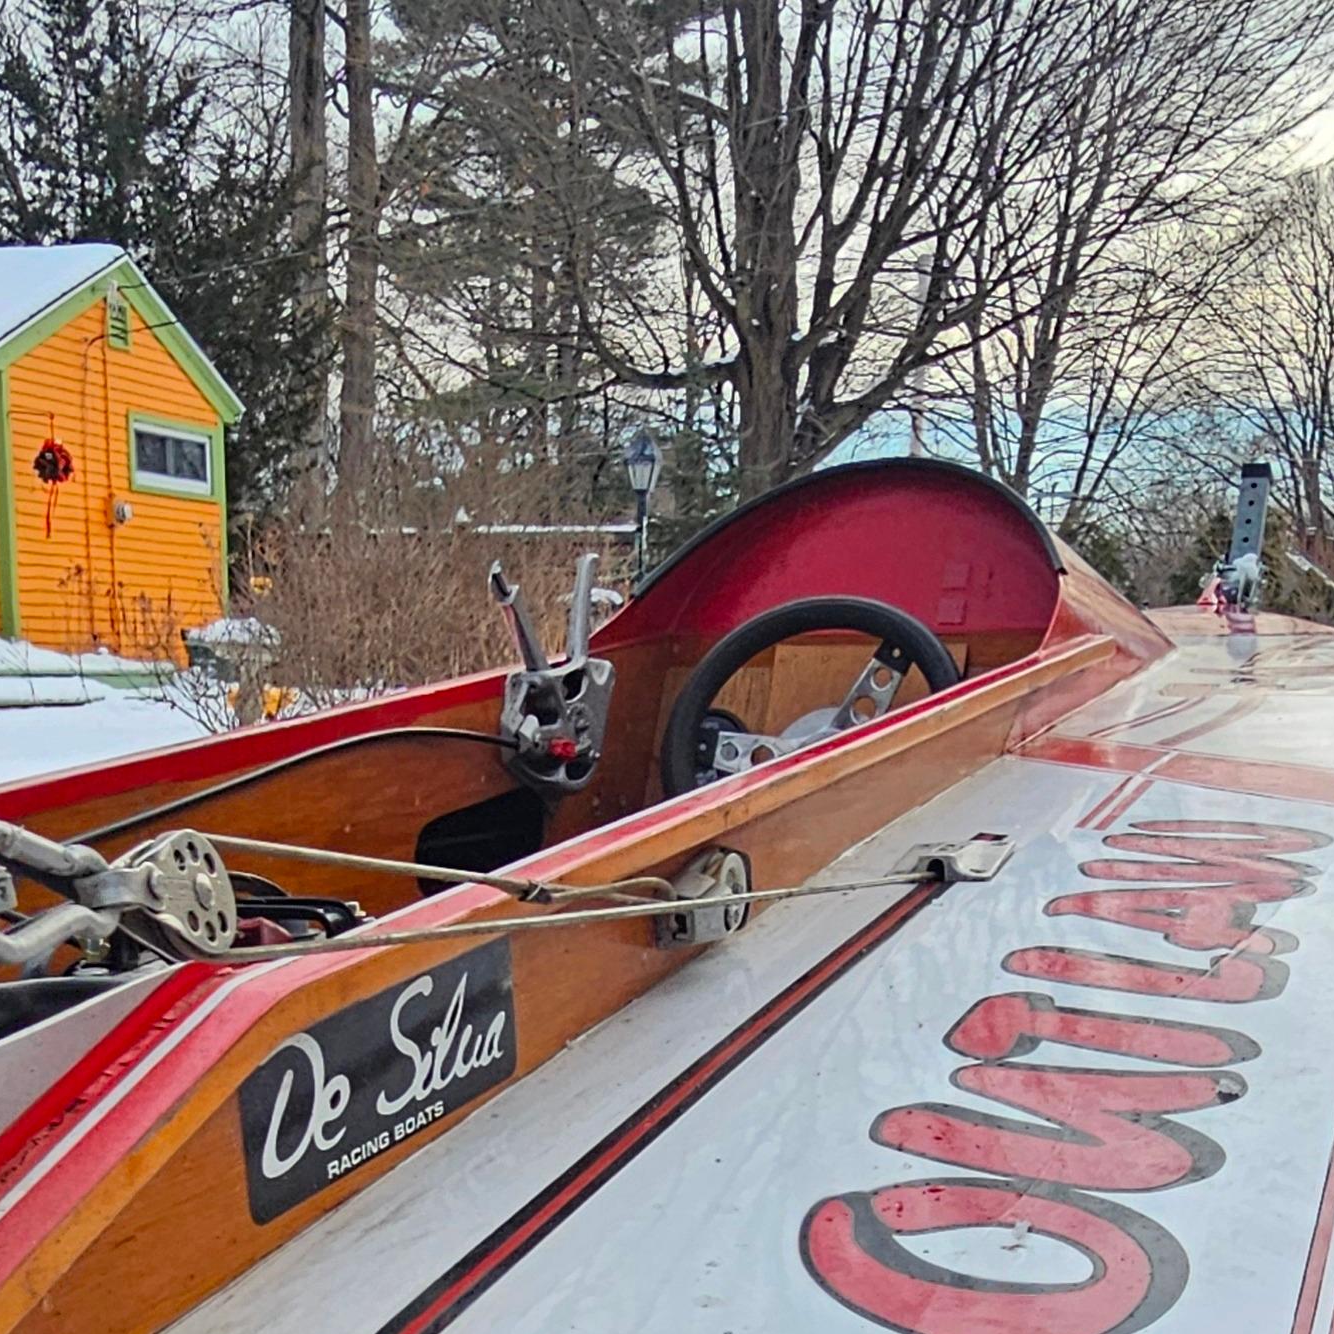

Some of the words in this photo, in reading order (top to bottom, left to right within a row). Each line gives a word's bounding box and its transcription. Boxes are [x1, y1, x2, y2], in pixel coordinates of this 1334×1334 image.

[261, 1032, 351, 1179] De
[327, 1132, 390, 1180] RACING
[394, 1100, 445, 1143] BOATS
